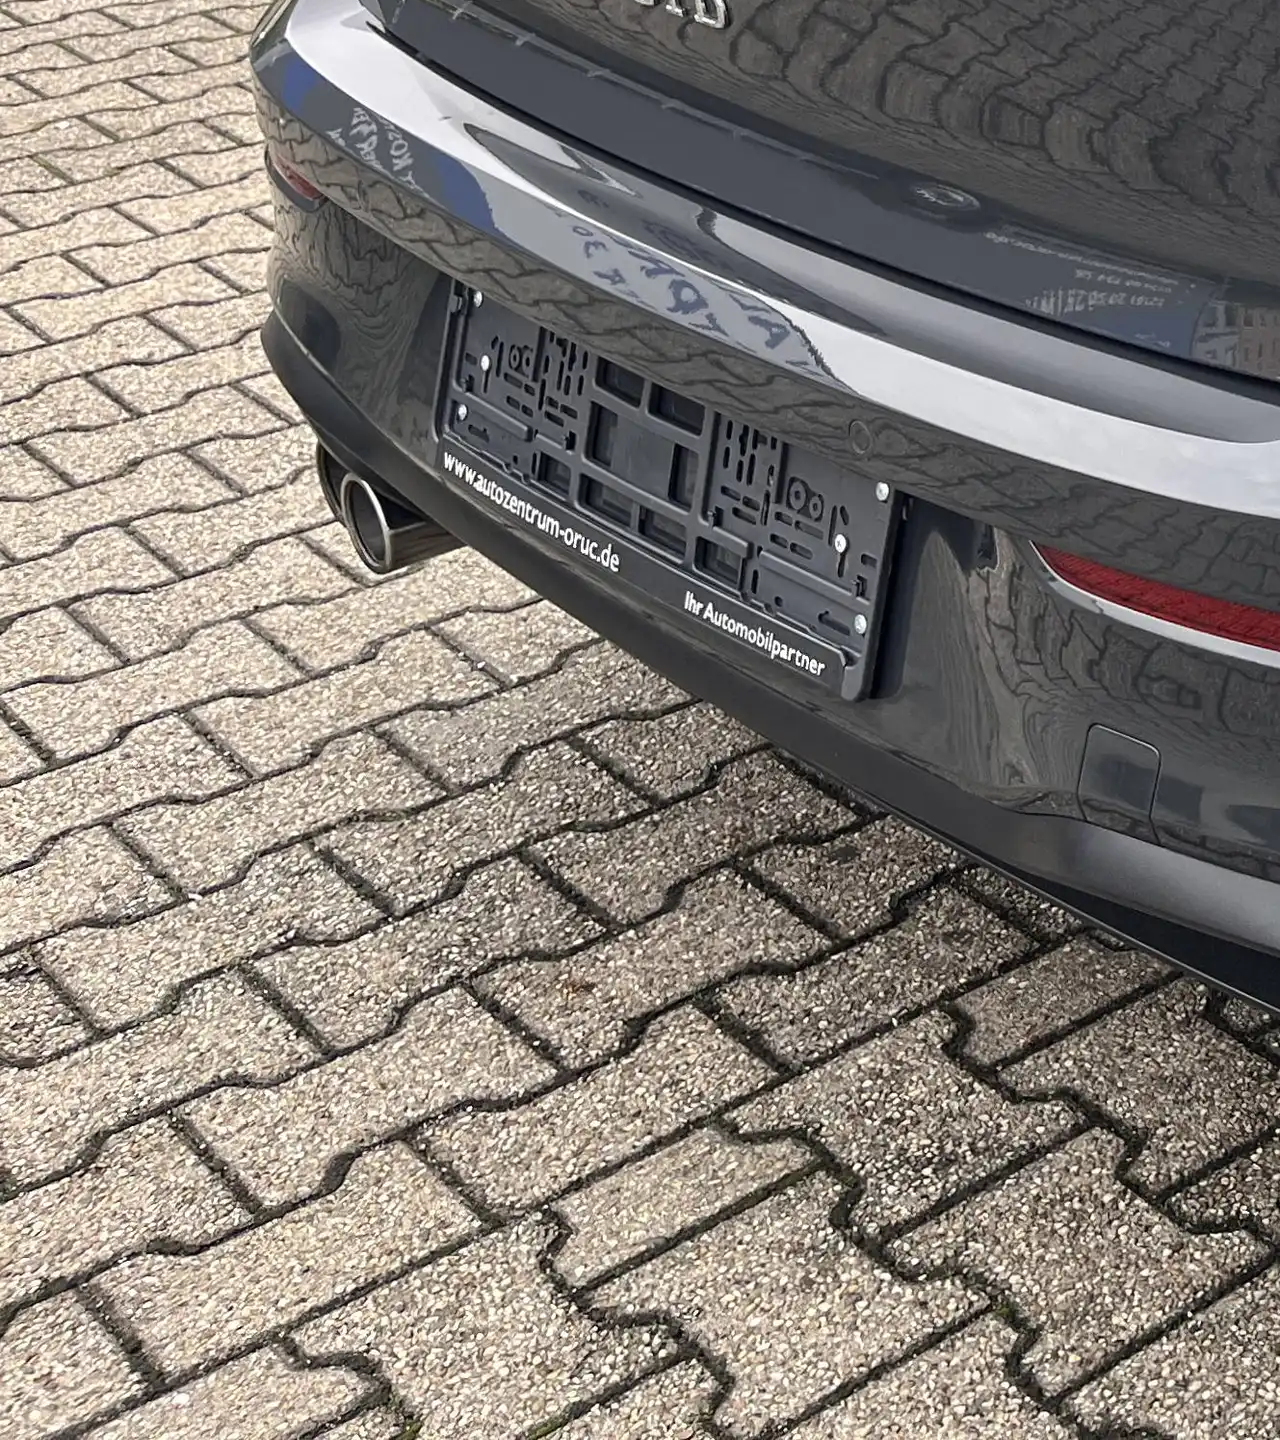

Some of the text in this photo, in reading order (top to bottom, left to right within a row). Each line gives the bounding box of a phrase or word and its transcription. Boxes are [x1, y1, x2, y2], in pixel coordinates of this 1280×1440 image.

[443, 451, 621, 573] www.autozentrum-oruc.de
[684, 590, 826, 677] Ihr Automobilpartner
